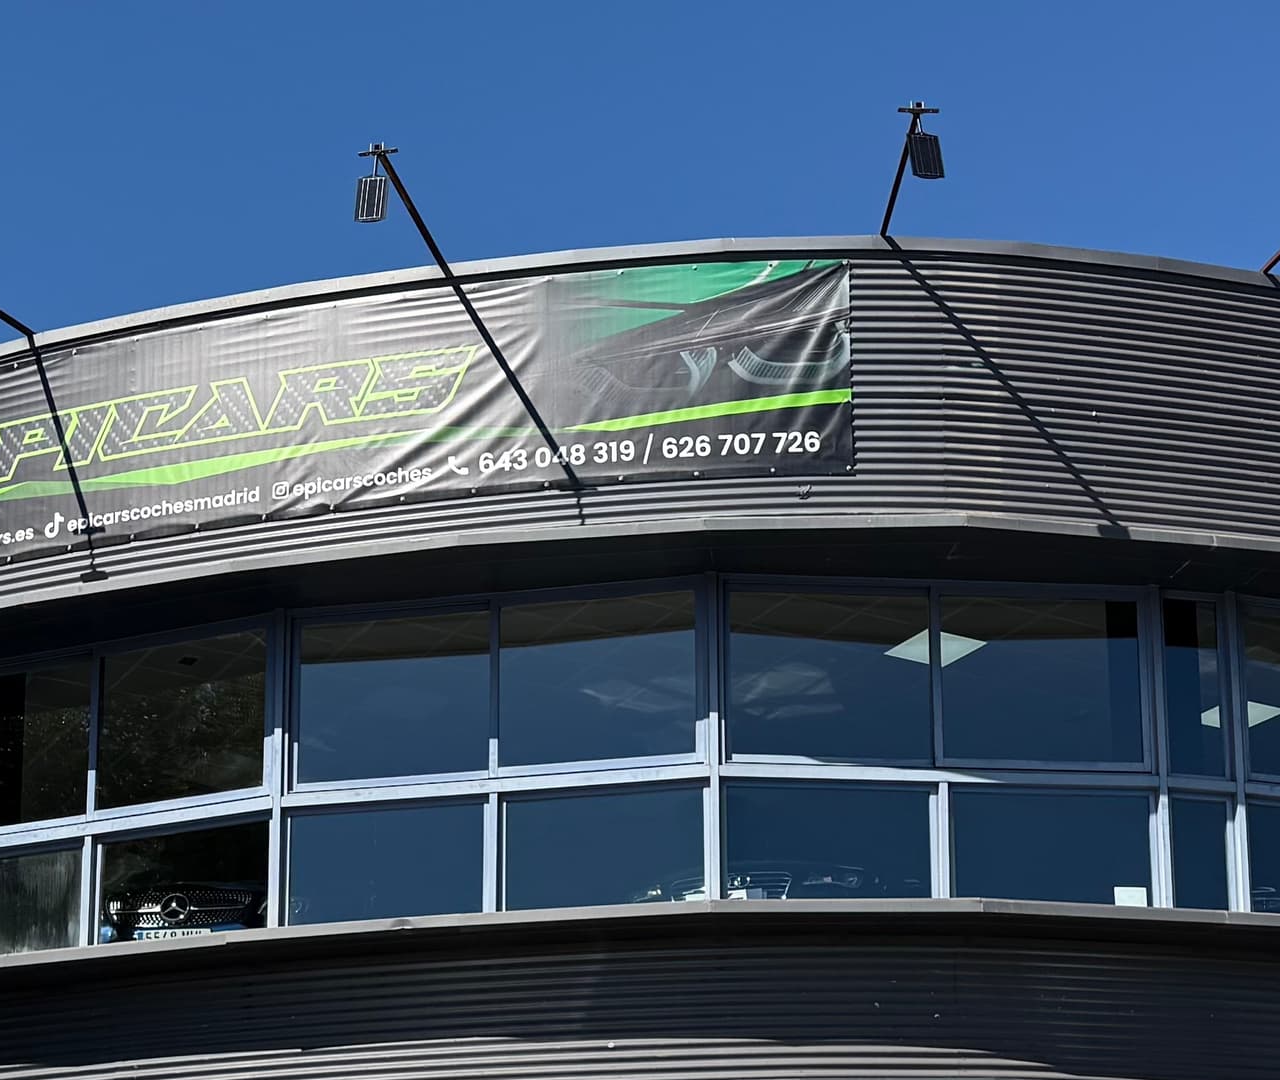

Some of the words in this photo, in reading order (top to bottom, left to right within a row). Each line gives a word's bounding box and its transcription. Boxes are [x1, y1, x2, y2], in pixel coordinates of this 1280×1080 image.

[66, 486, 260, 535] epicarscochesmadrid
[293, 464, 433, 498] epicarscoches
[478, 449, 528, 474] 643
[535, 444, 587, 469] 048
[593, 441, 636, 464] 319
[642, 433, 654, 465] /
[662, 436, 715, 459] 626
[718, 433, 767, 457] 707
[772, 430, 822, 454] 726
